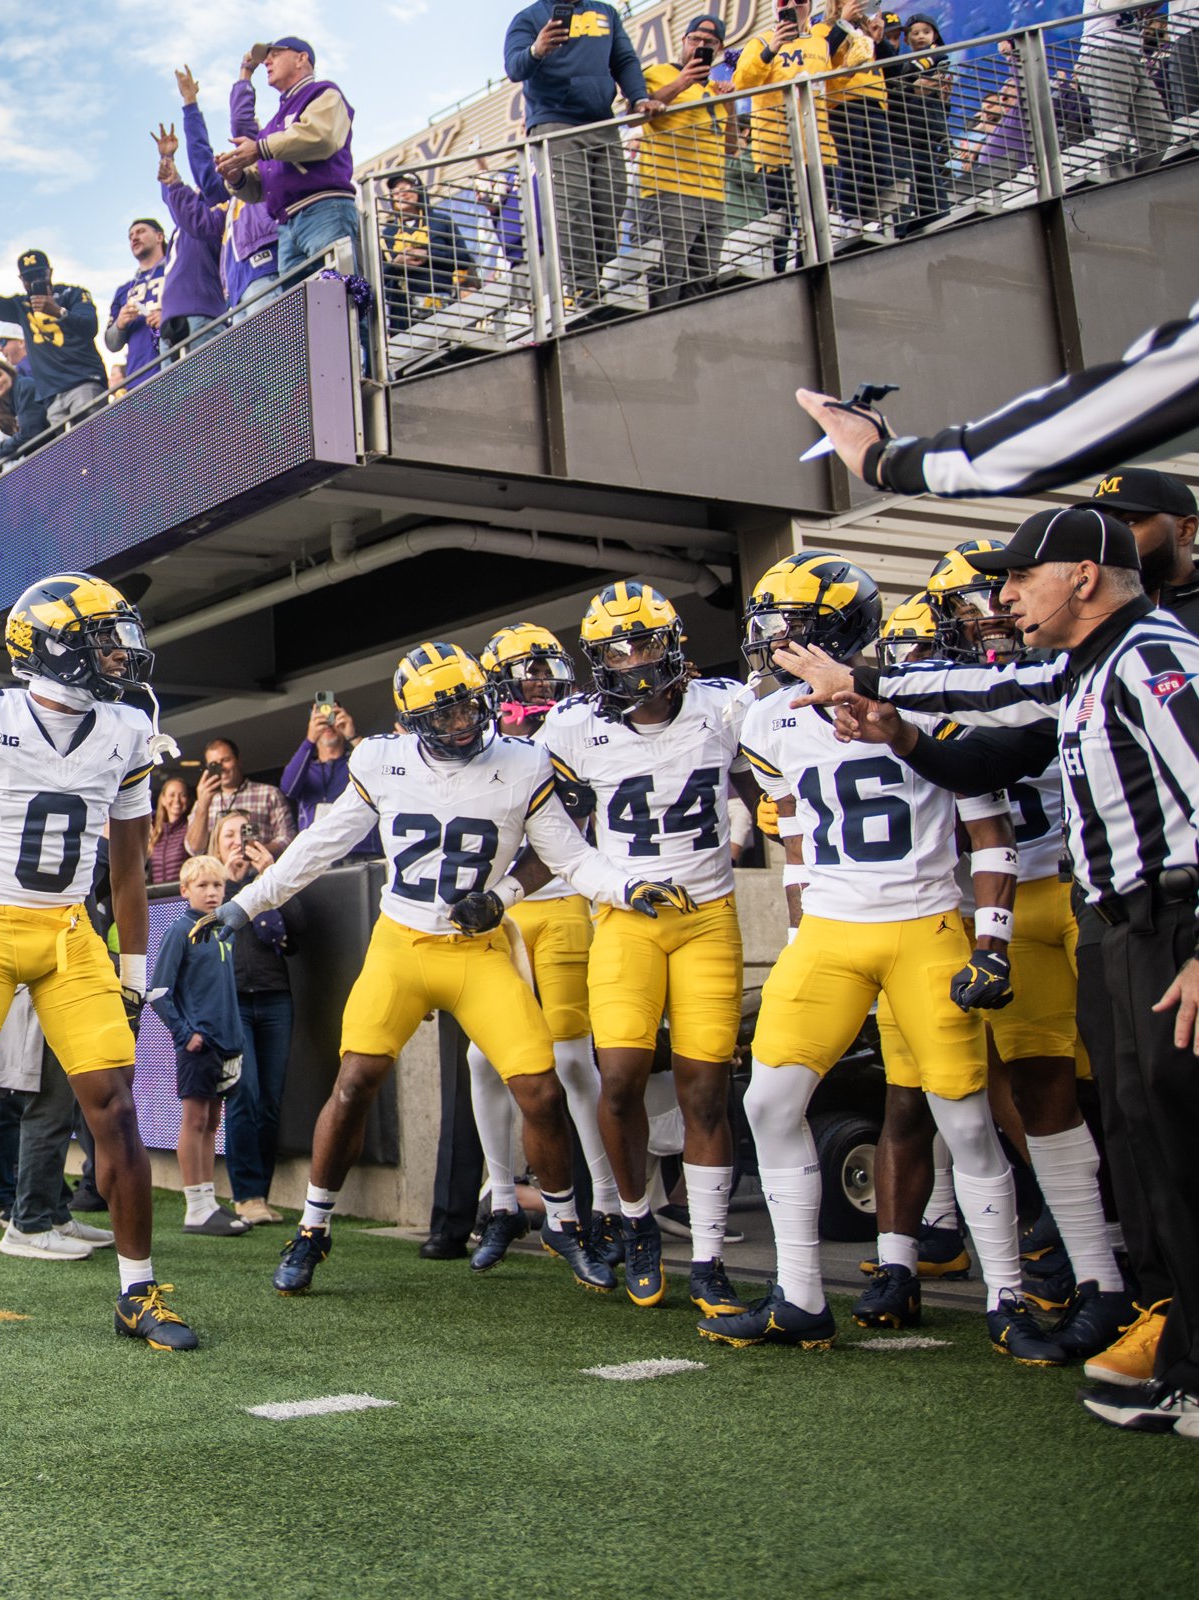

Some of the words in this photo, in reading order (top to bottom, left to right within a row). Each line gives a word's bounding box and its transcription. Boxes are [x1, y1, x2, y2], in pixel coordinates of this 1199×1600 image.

[779, 49, 804, 67] M
[23, 255, 37, 266] M
[1095, 476, 1123, 498] M
[1063, 747, 1085, 776] H
[607, 767, 721, 857] 44
[797, 755, 914, 865] 16
[14, 791, 88, 893] 0
[391, 812, 499, 905] 28
[992, 912, 1009, 925] M
